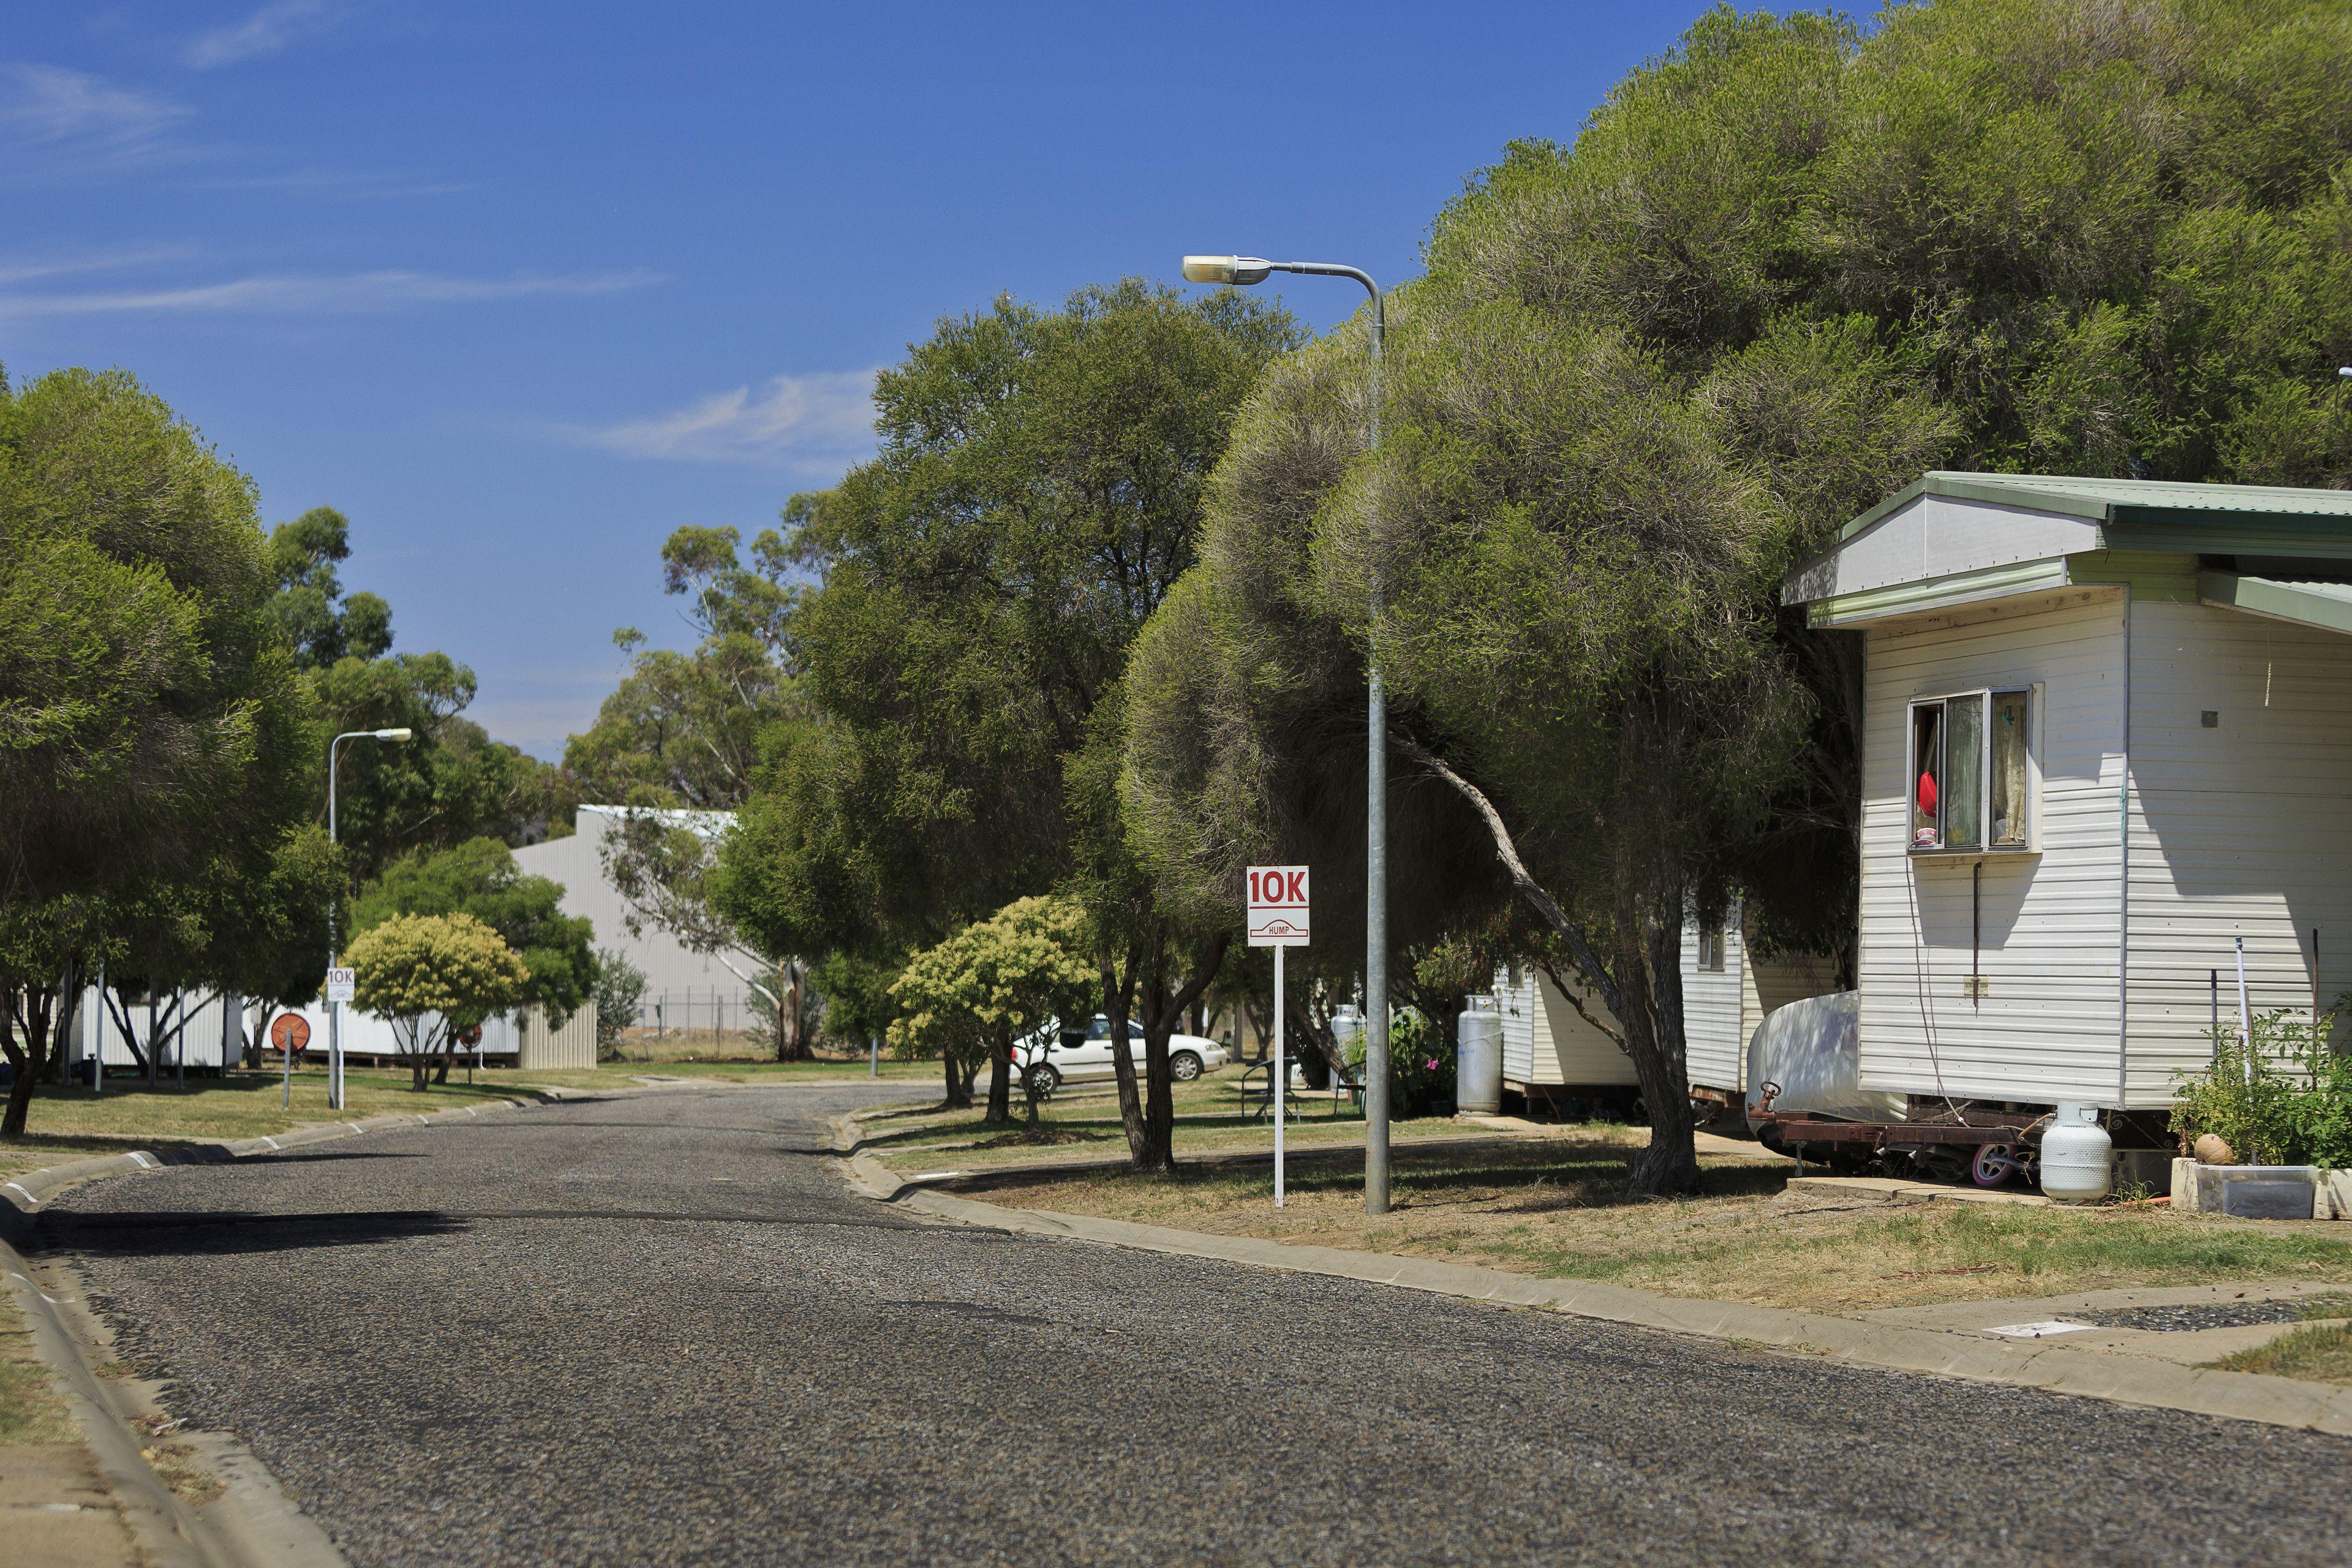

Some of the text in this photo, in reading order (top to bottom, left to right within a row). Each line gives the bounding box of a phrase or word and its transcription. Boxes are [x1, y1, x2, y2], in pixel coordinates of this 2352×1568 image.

[1250, 871, 1306, 903] 10K
[1269, 926, 1289, 935] HUMP
[330, 971, 353, 983] 10K
